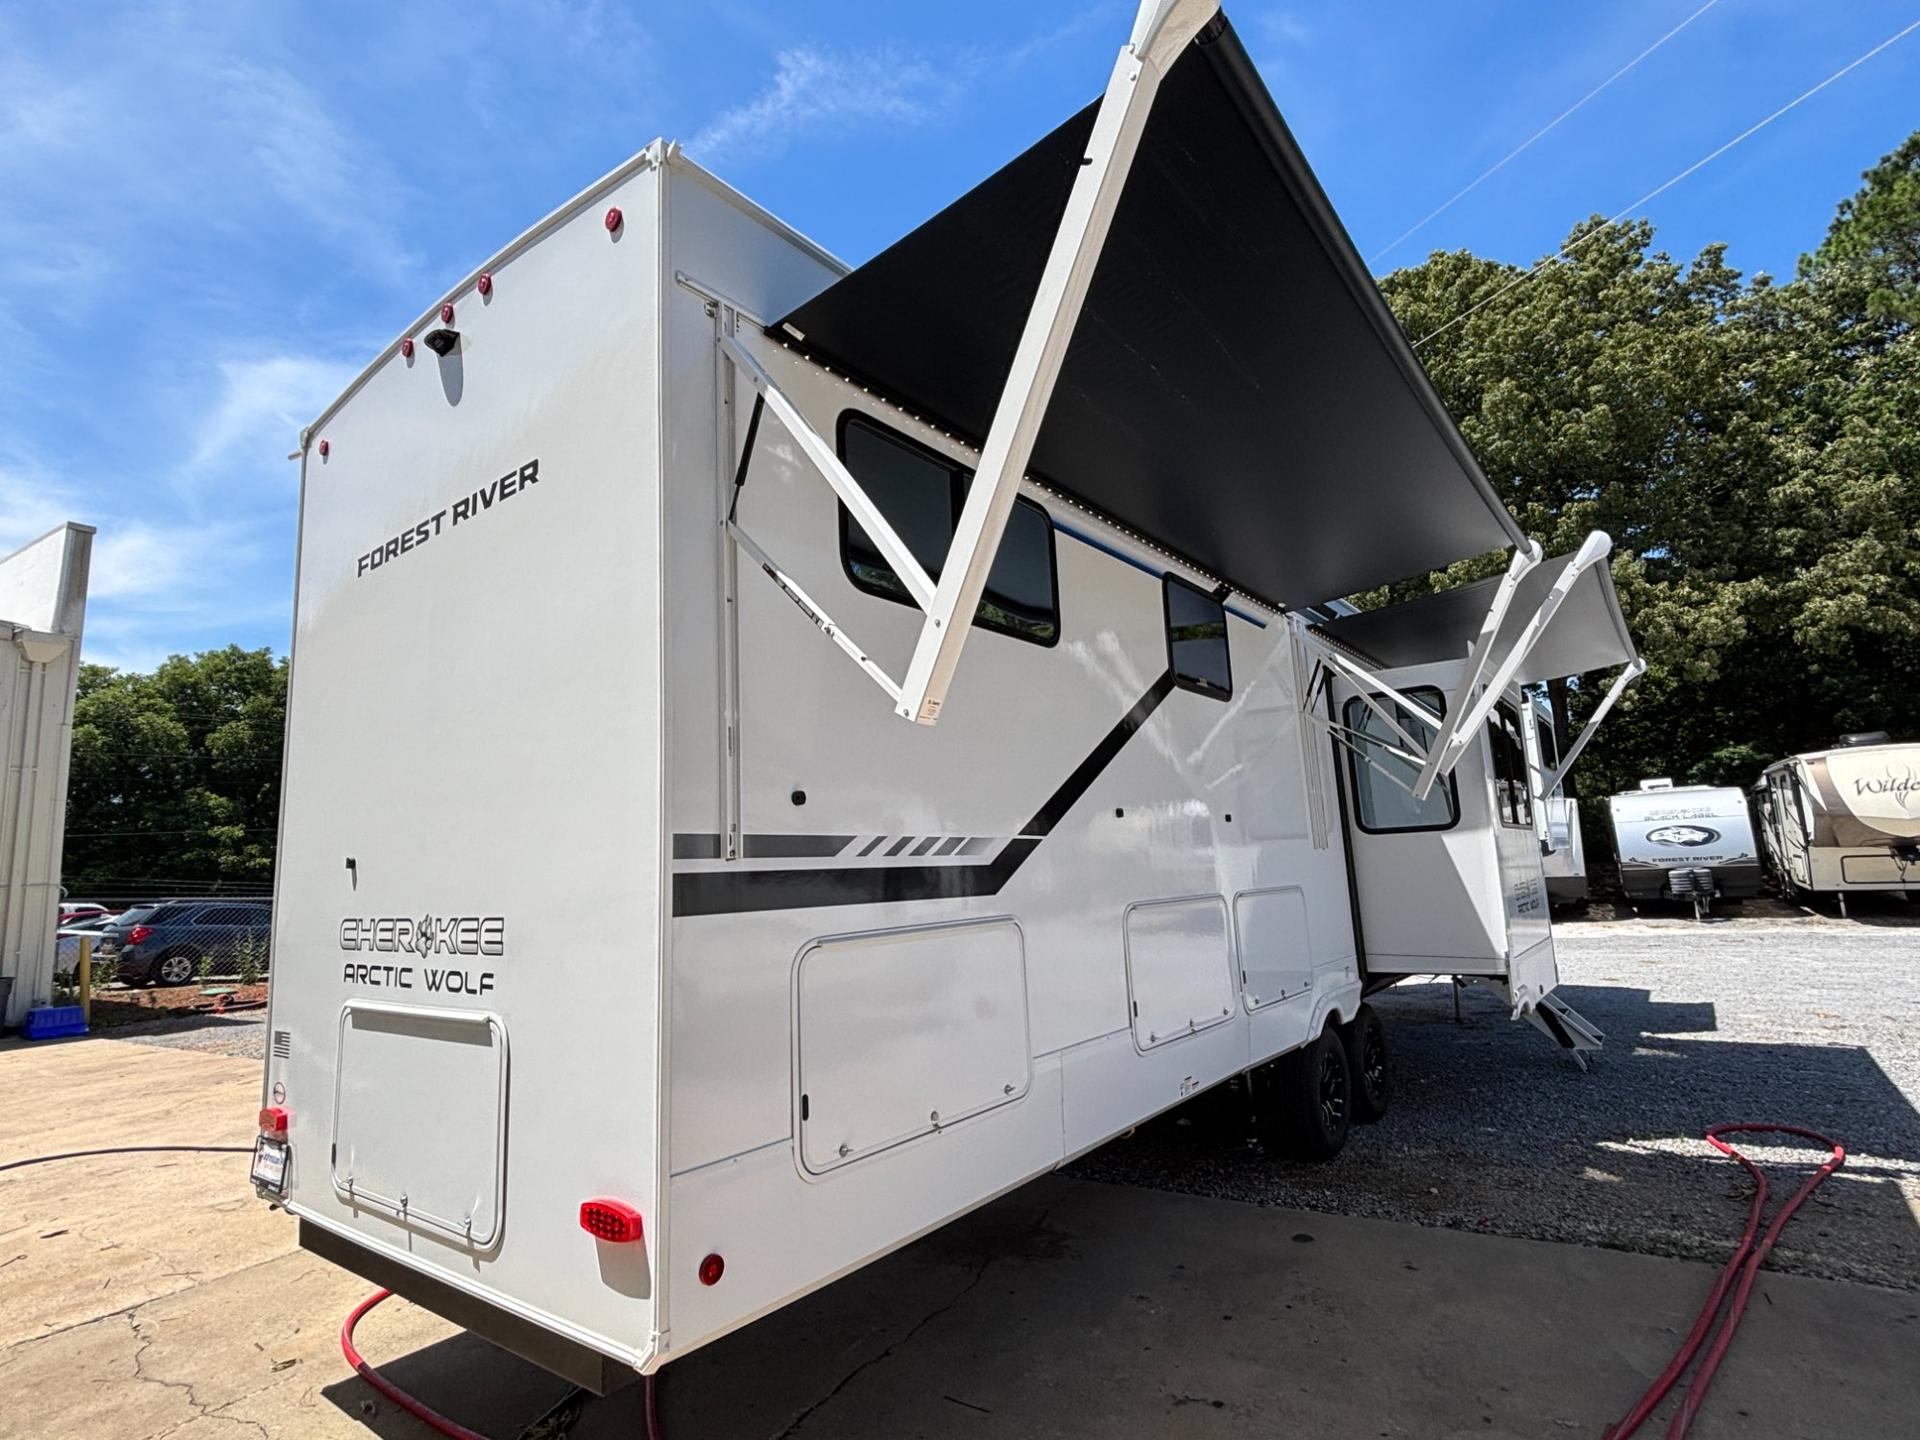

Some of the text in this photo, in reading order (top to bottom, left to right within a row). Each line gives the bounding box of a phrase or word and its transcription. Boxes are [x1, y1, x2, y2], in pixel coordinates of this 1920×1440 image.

[357, 458, 540, 578] FOREST RIVER
[343, 963, 494, 995] ARCTIC WOLF
